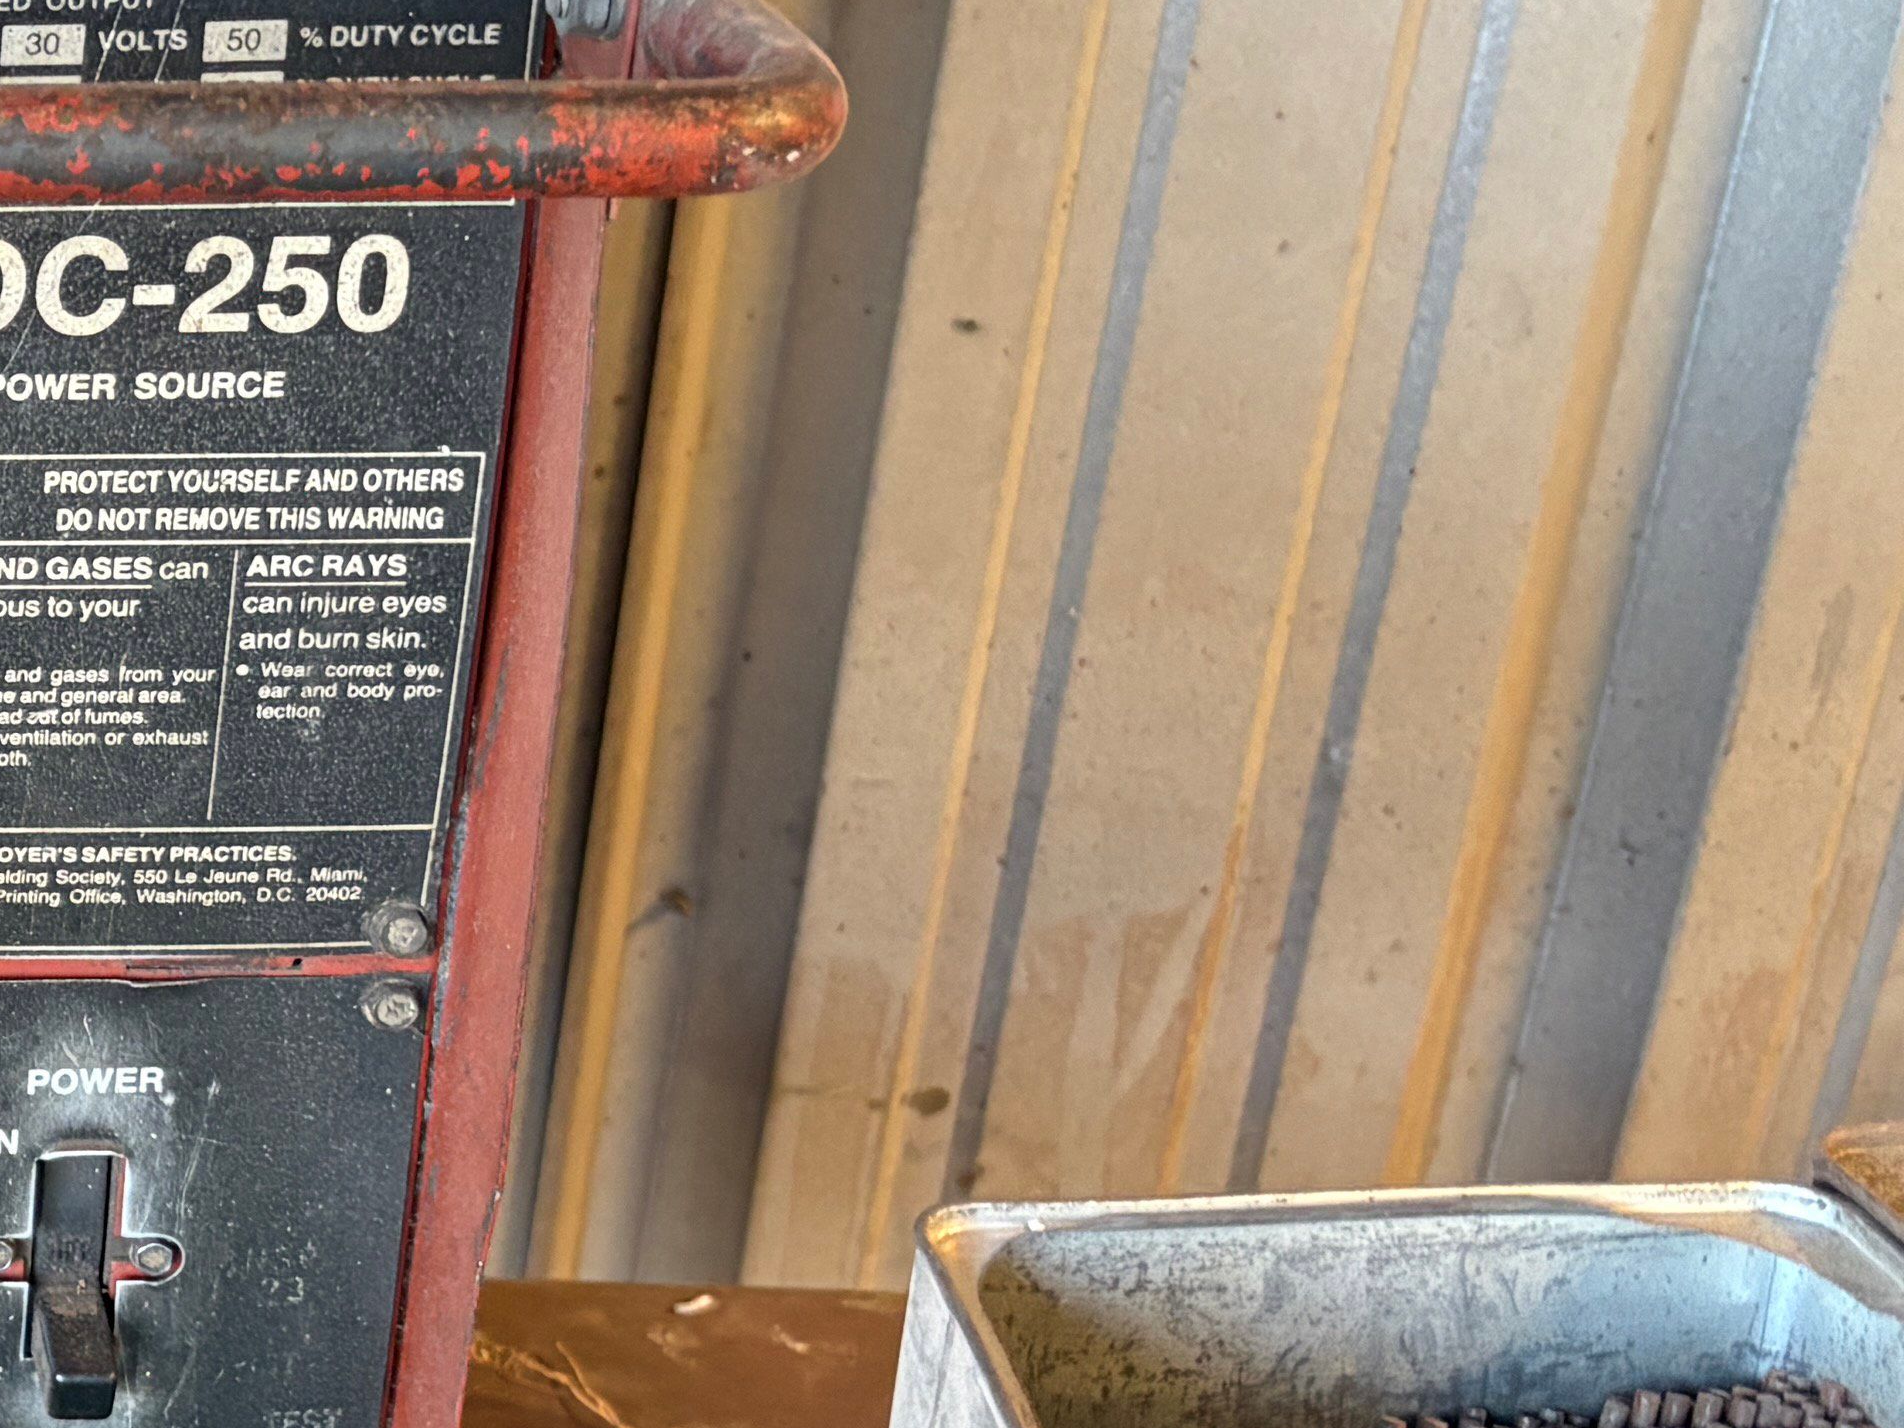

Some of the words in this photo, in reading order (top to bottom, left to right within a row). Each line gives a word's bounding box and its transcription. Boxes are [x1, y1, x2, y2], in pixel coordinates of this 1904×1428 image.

[26, 32, 60, 56] 30
[98, 31, 188, 51] VOLTS
[227, 28, 261, 50] 50
[330, 25, 404, 47] DUTY
[410, 24, 501, 45] CYCLE
[134, 371, 286, 399] SOURCE
[44, 470, 163, 494] PROTECT
[168, 469, 301, 493] YOURSELF
[305, 469, 358, 491] AND
[363, 468, 464, 492] OTHERS
[56, 508, 93, 531] DO
[98, 508, 151, 531] NOT
[155, 507, 261, 530] REMOVE
[266, 507, 321, 530] THIS
[328, 507, 444, 529] WARNING
[46, 557, 153, 580] GASES
[159, 561, 208, 579] can
[247, 555, 314, 577] ARC
[322, 554, 406, 576] RAYS
[243, 596, 292, 613] can
[301, 592, 375, 618] injure
[383, 596, 446, 618] eyes
[27, 1067, 164, 1095] POWER
